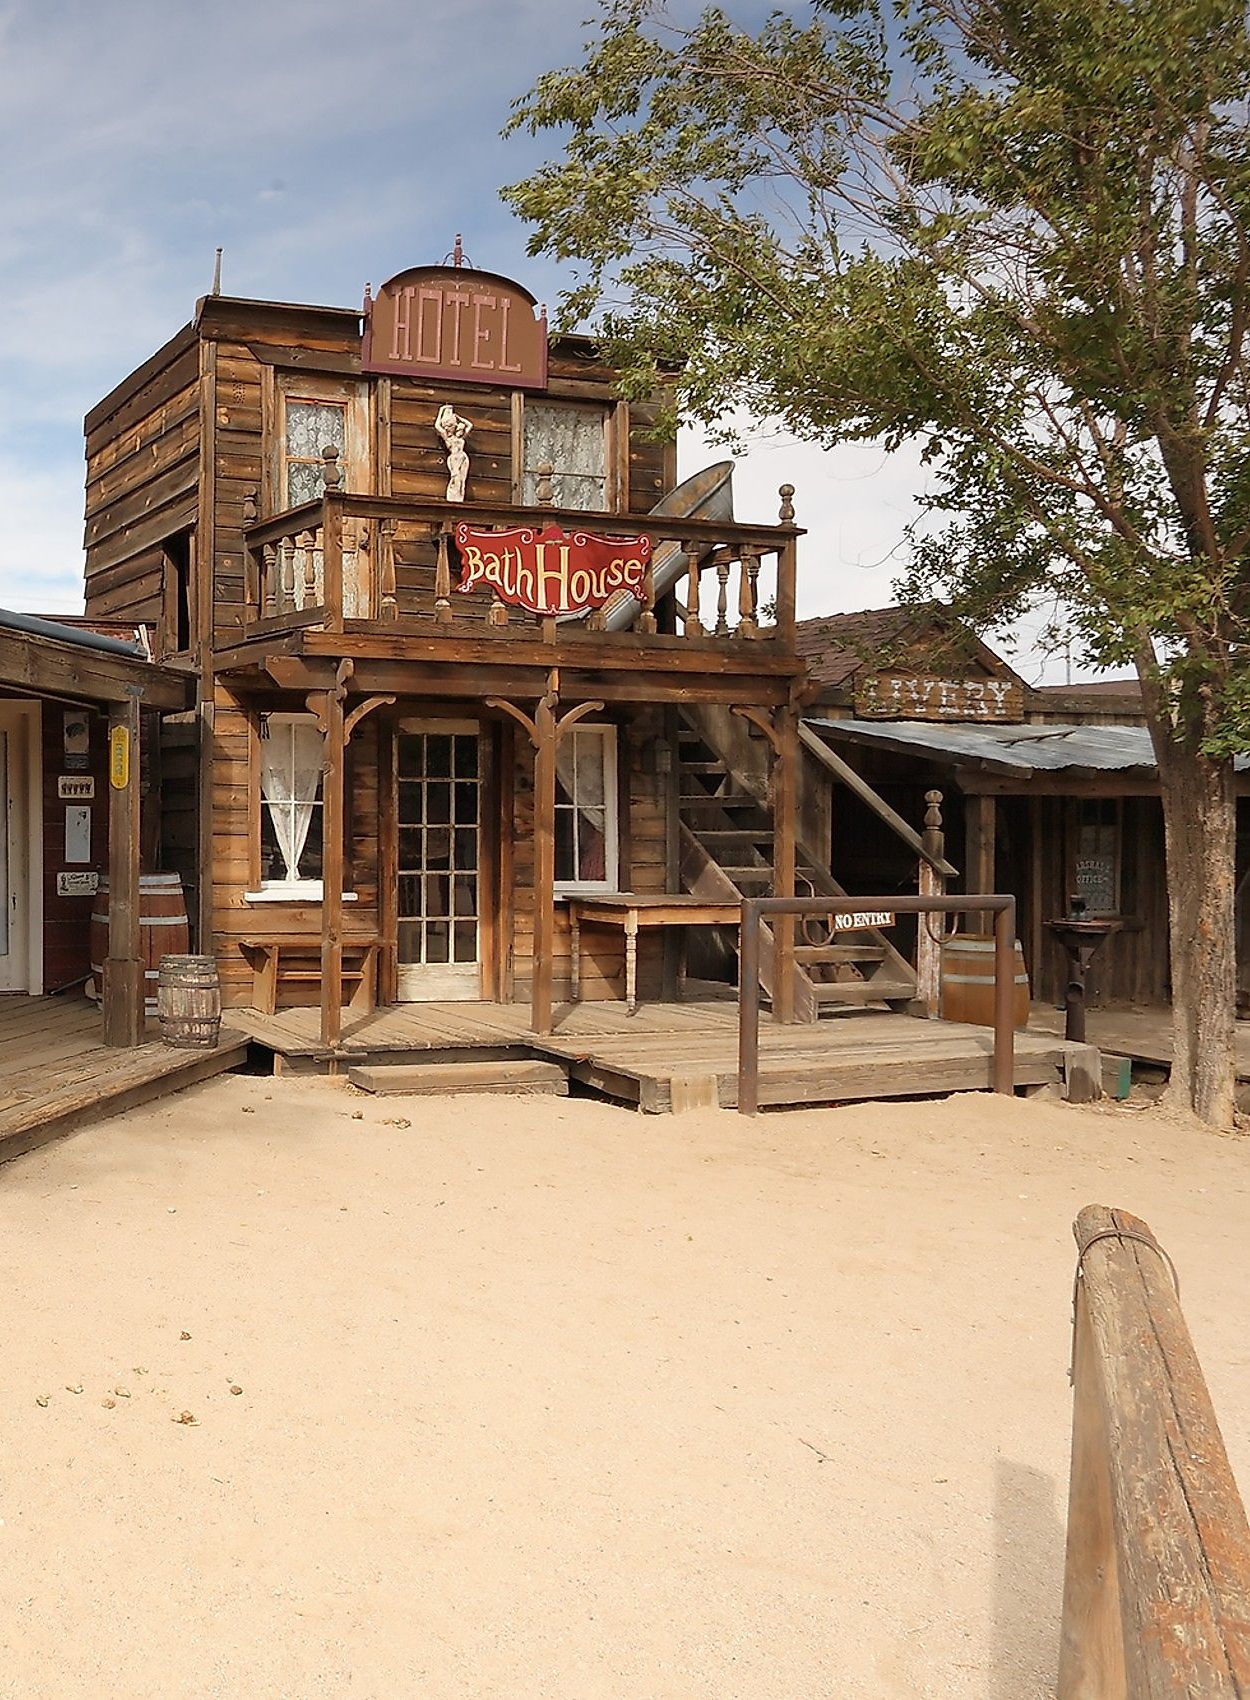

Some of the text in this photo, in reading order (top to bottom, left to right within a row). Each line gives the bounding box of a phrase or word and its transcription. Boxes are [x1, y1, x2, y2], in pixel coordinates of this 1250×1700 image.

[389, 286, 522, 373] HOTEL
[835, 911, 891, 930] NO ENTRY
